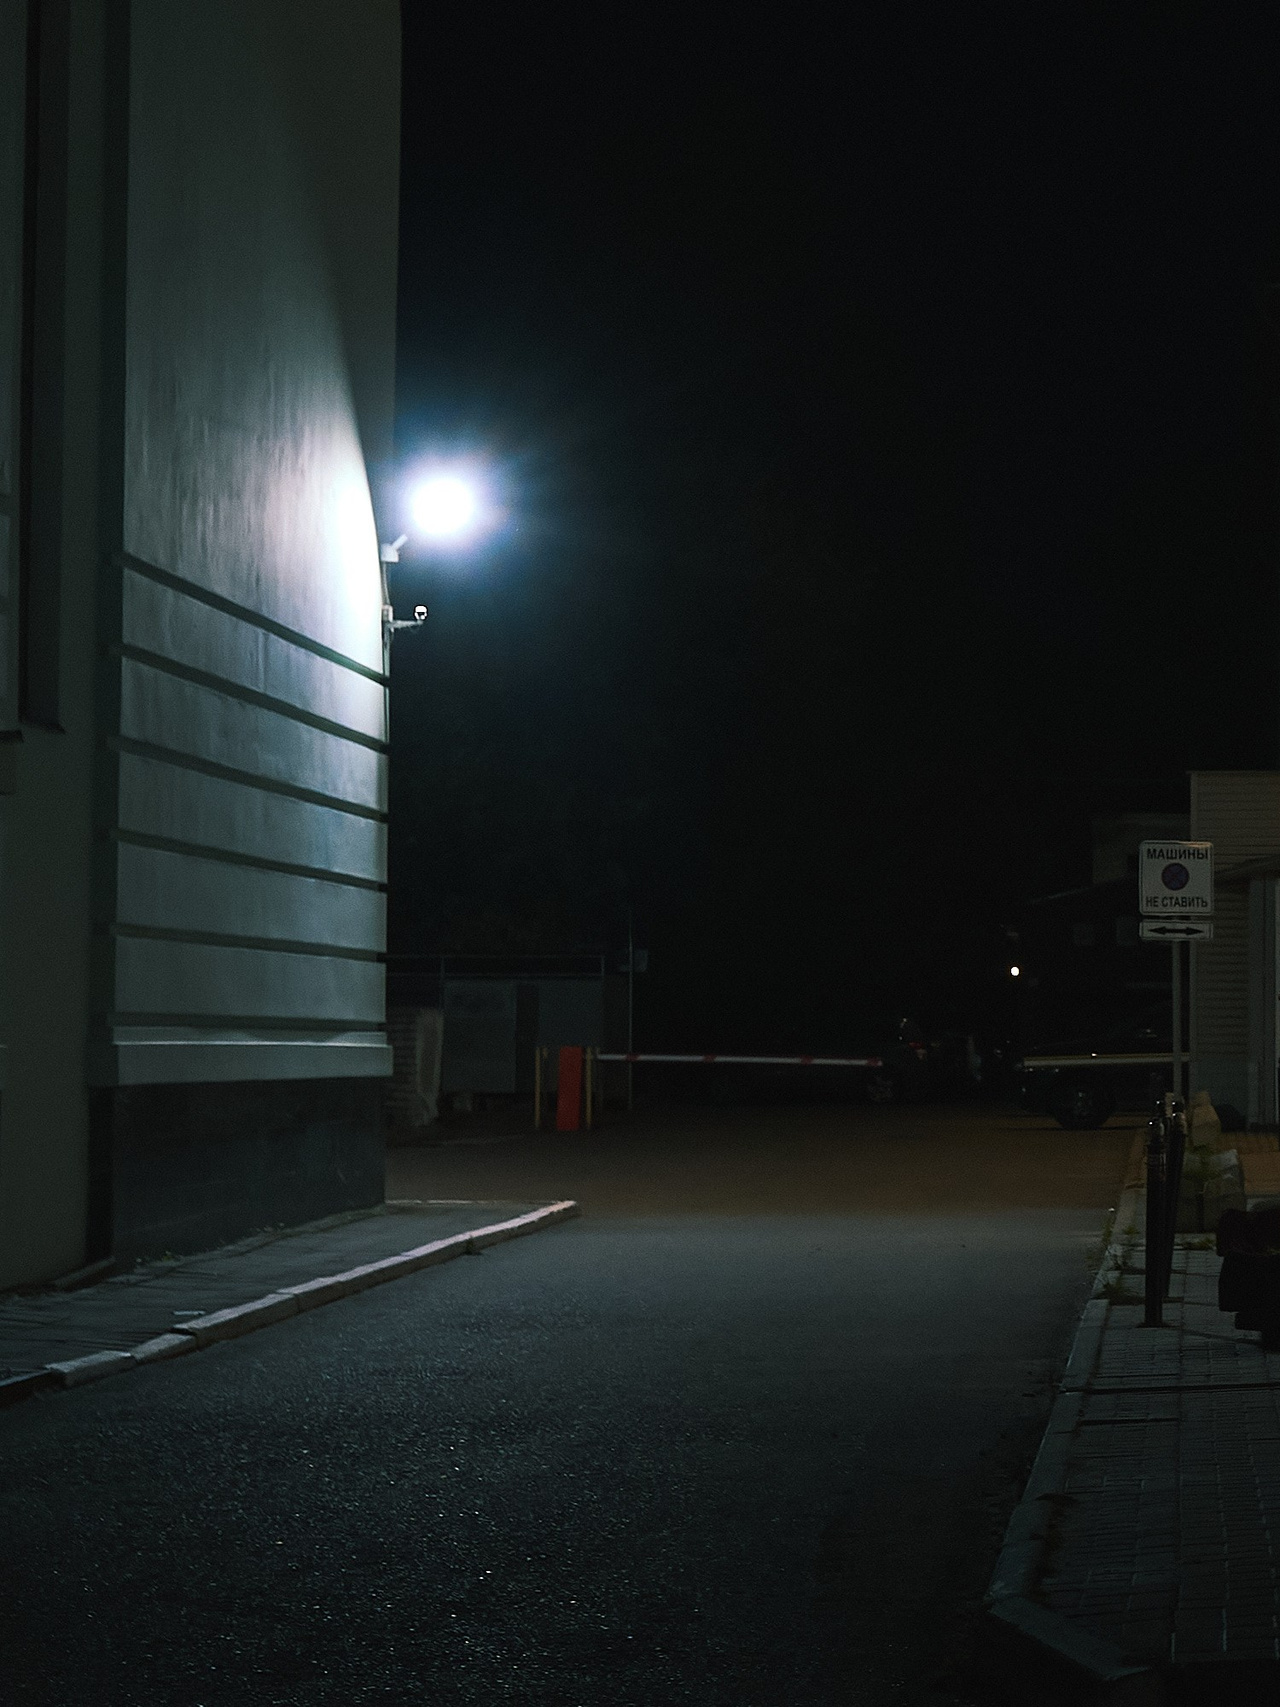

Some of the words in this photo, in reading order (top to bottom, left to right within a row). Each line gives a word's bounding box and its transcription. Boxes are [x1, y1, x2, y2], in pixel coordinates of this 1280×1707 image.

[1147, 848, 1208, 860] МАШИНЫ
[1146, 896, 1159, 908] НЕ
[1161, 896, 1208, 908] СТАВИТЬ
